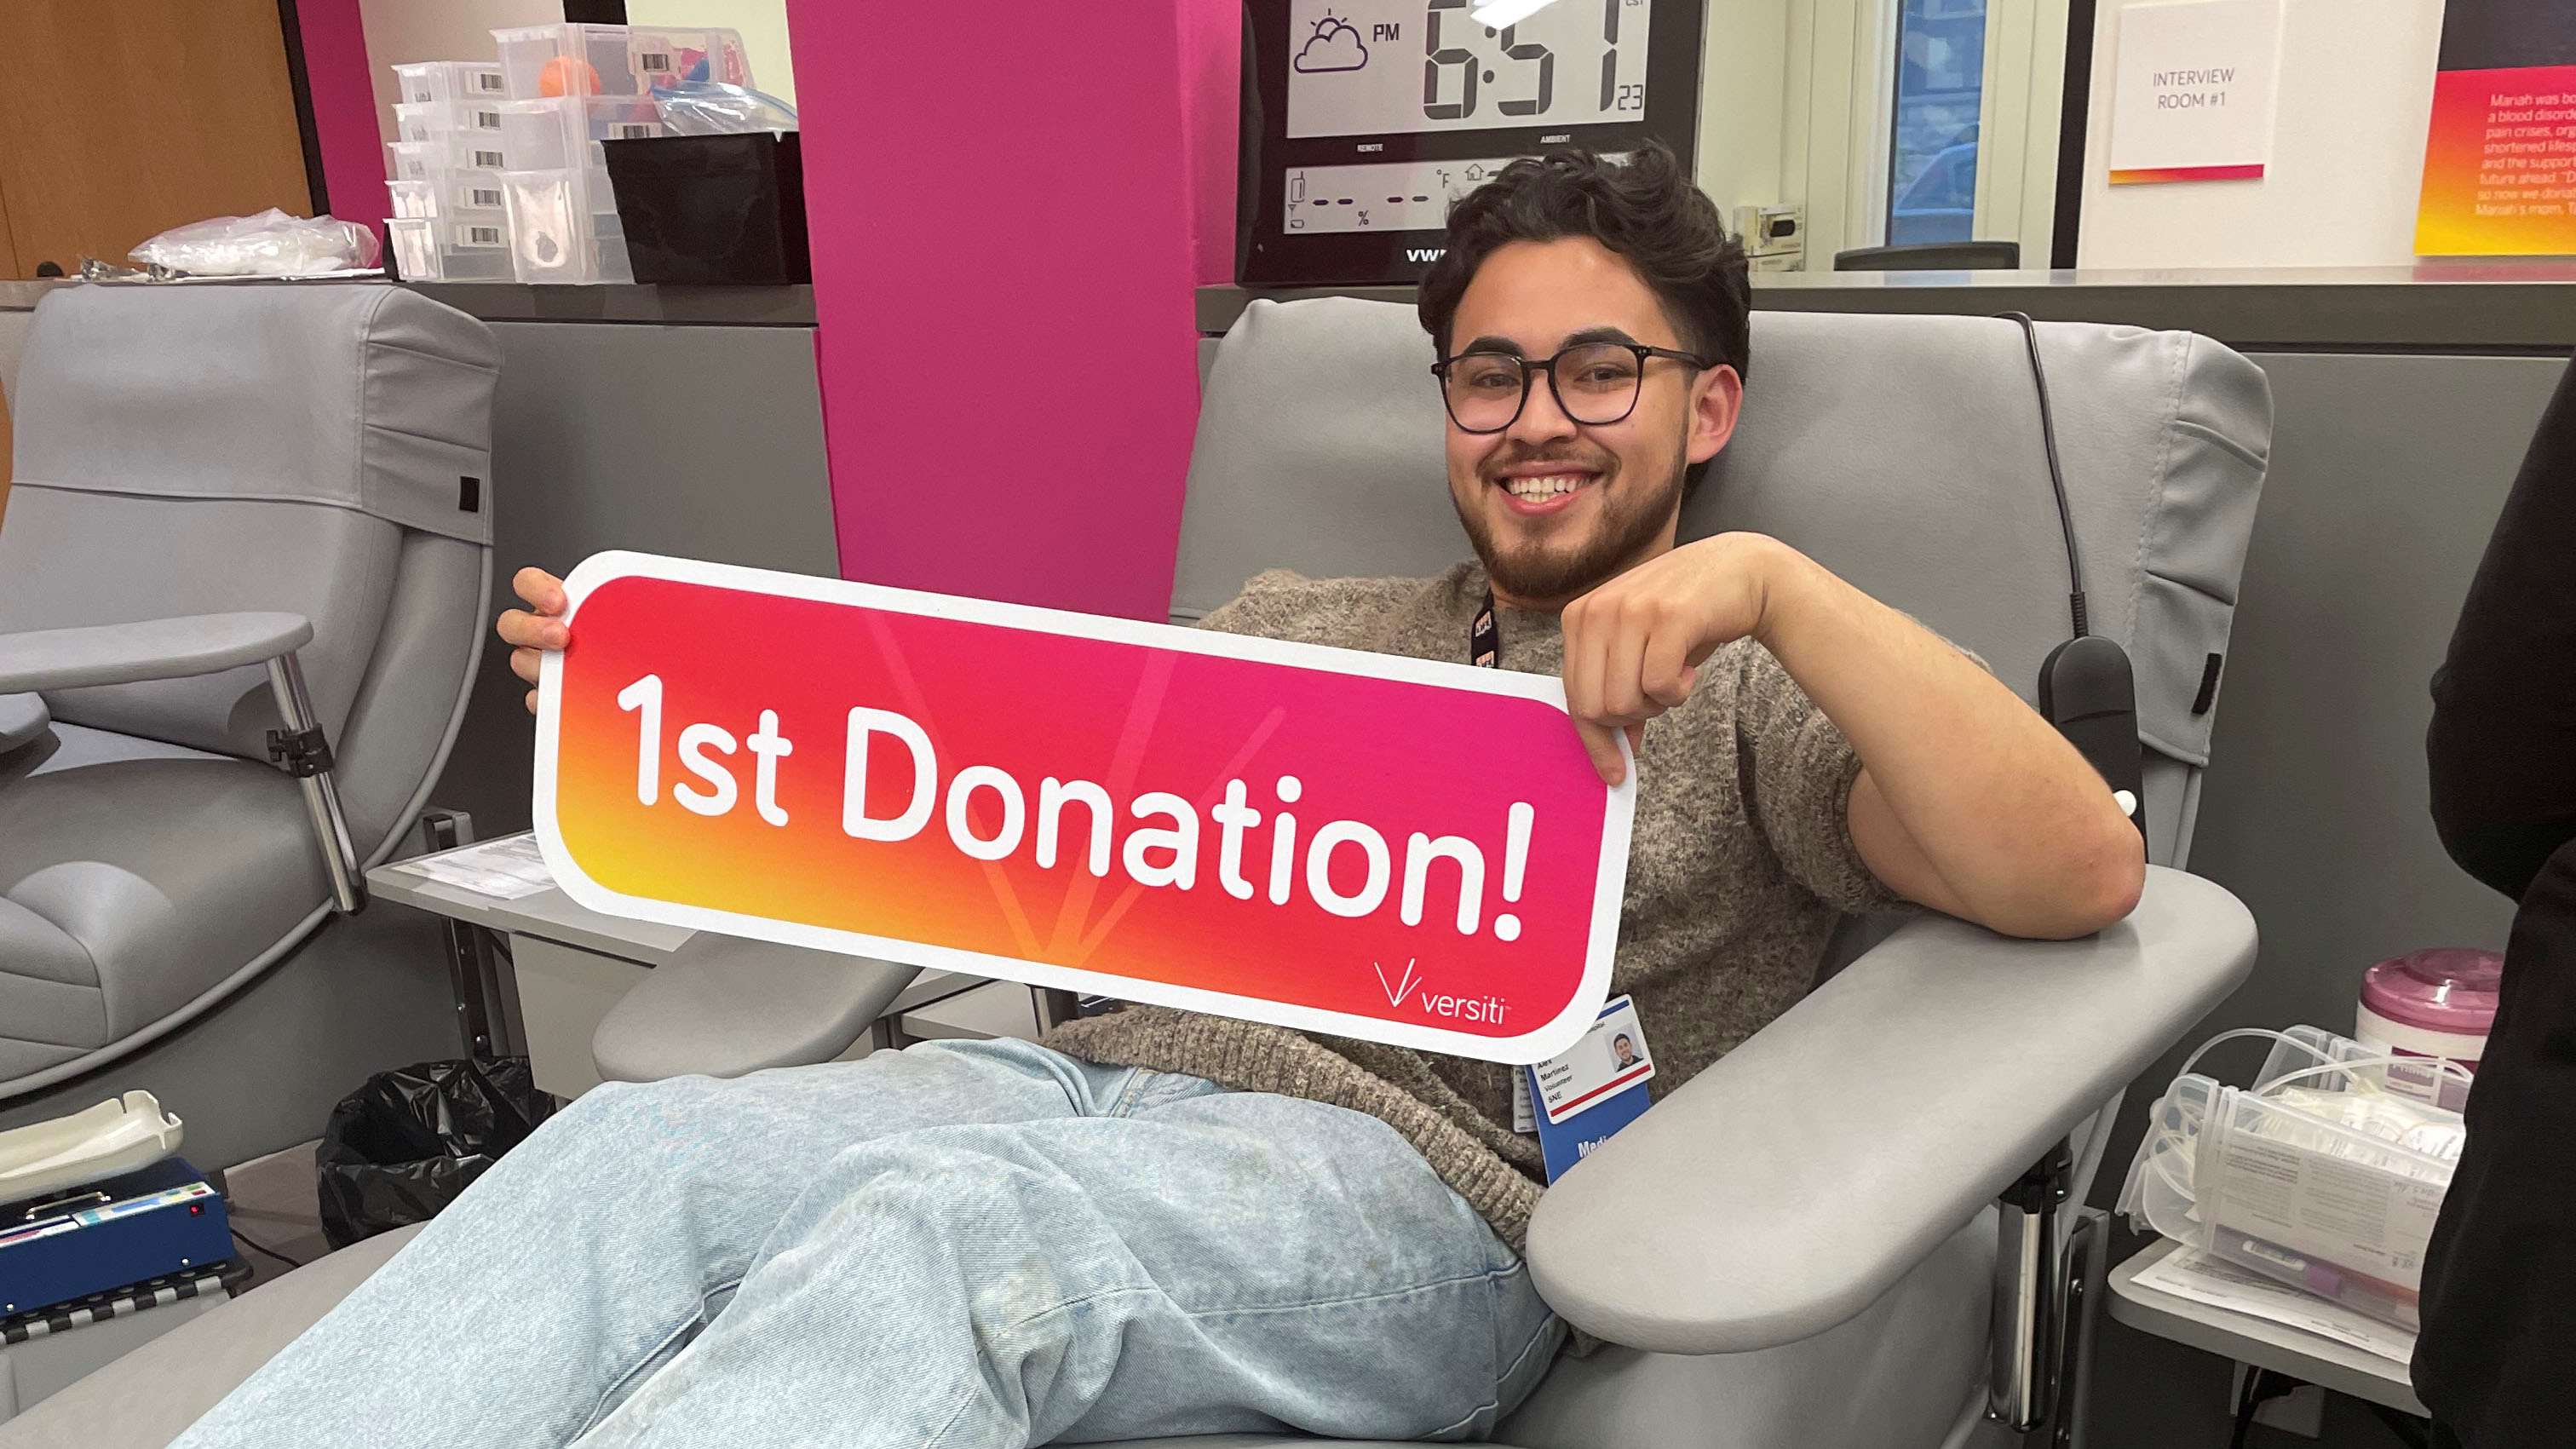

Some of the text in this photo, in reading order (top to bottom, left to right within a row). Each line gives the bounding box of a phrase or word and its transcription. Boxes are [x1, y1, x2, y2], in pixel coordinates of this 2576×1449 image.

[1372, 23, 1400, 42] PM
[2153, 67, 2235, 86] INTERVIEW
[1618, 84, 1643, 111] 23
[2158, 91, 2225, 109] ROOM #1
[2490, 95, 2532, 106] Mariah
[2535, 95, 2559, 106] was
[2487, 112, 2496, 123] a
[2498, 110, 2533, 123] blood
[1540, 133, 1571, 144] AMBIENT
[2486, 128, 2512, 140] pain
[2484, 141, 2546, 154] shortened
[2481, 158, 2504, 169] and
[2507, 158, 2527, 169] the
[2480, 173, 2515, 185] future
[2477, 191, 2492, 200] so
[2494, 190, 2518, 200] now
[2521, 189, 2539, 199] we
[617, 674, 1535, 942] 1st Donation!
[1421, 992, 1506, 1025] versiti
[1540, 1064, 1570, 1082] Martinez
[1544, 1075, 1573, 1092] Volunteer
